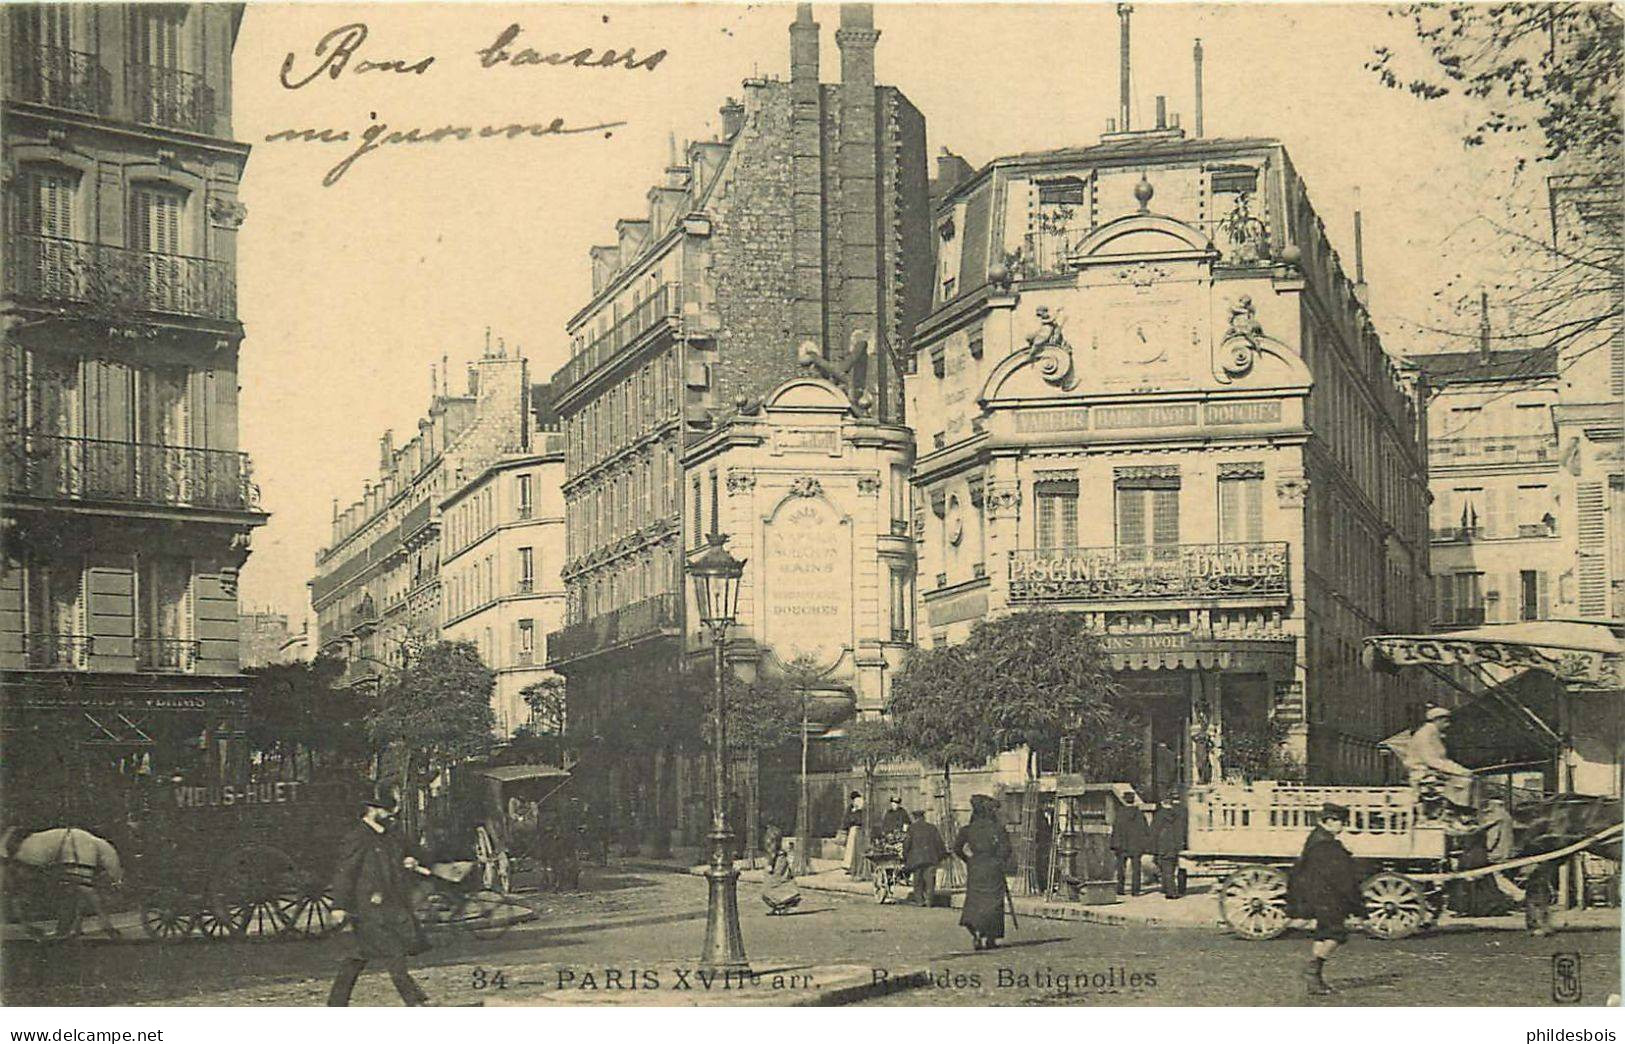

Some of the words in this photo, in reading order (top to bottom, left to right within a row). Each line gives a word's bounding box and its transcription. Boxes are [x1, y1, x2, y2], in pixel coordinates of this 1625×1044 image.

[280, 22, 436, 90] Bons
[1147, 404, 1193, 425] TIVOLI
[1208, 402, 1280, 422] DOUCHES
[1010, 556, 1109, 582] PISCINE
[1191, 549, 1285, 579] DAMES
[1141, 635, 1185, 649] TIVOLI
